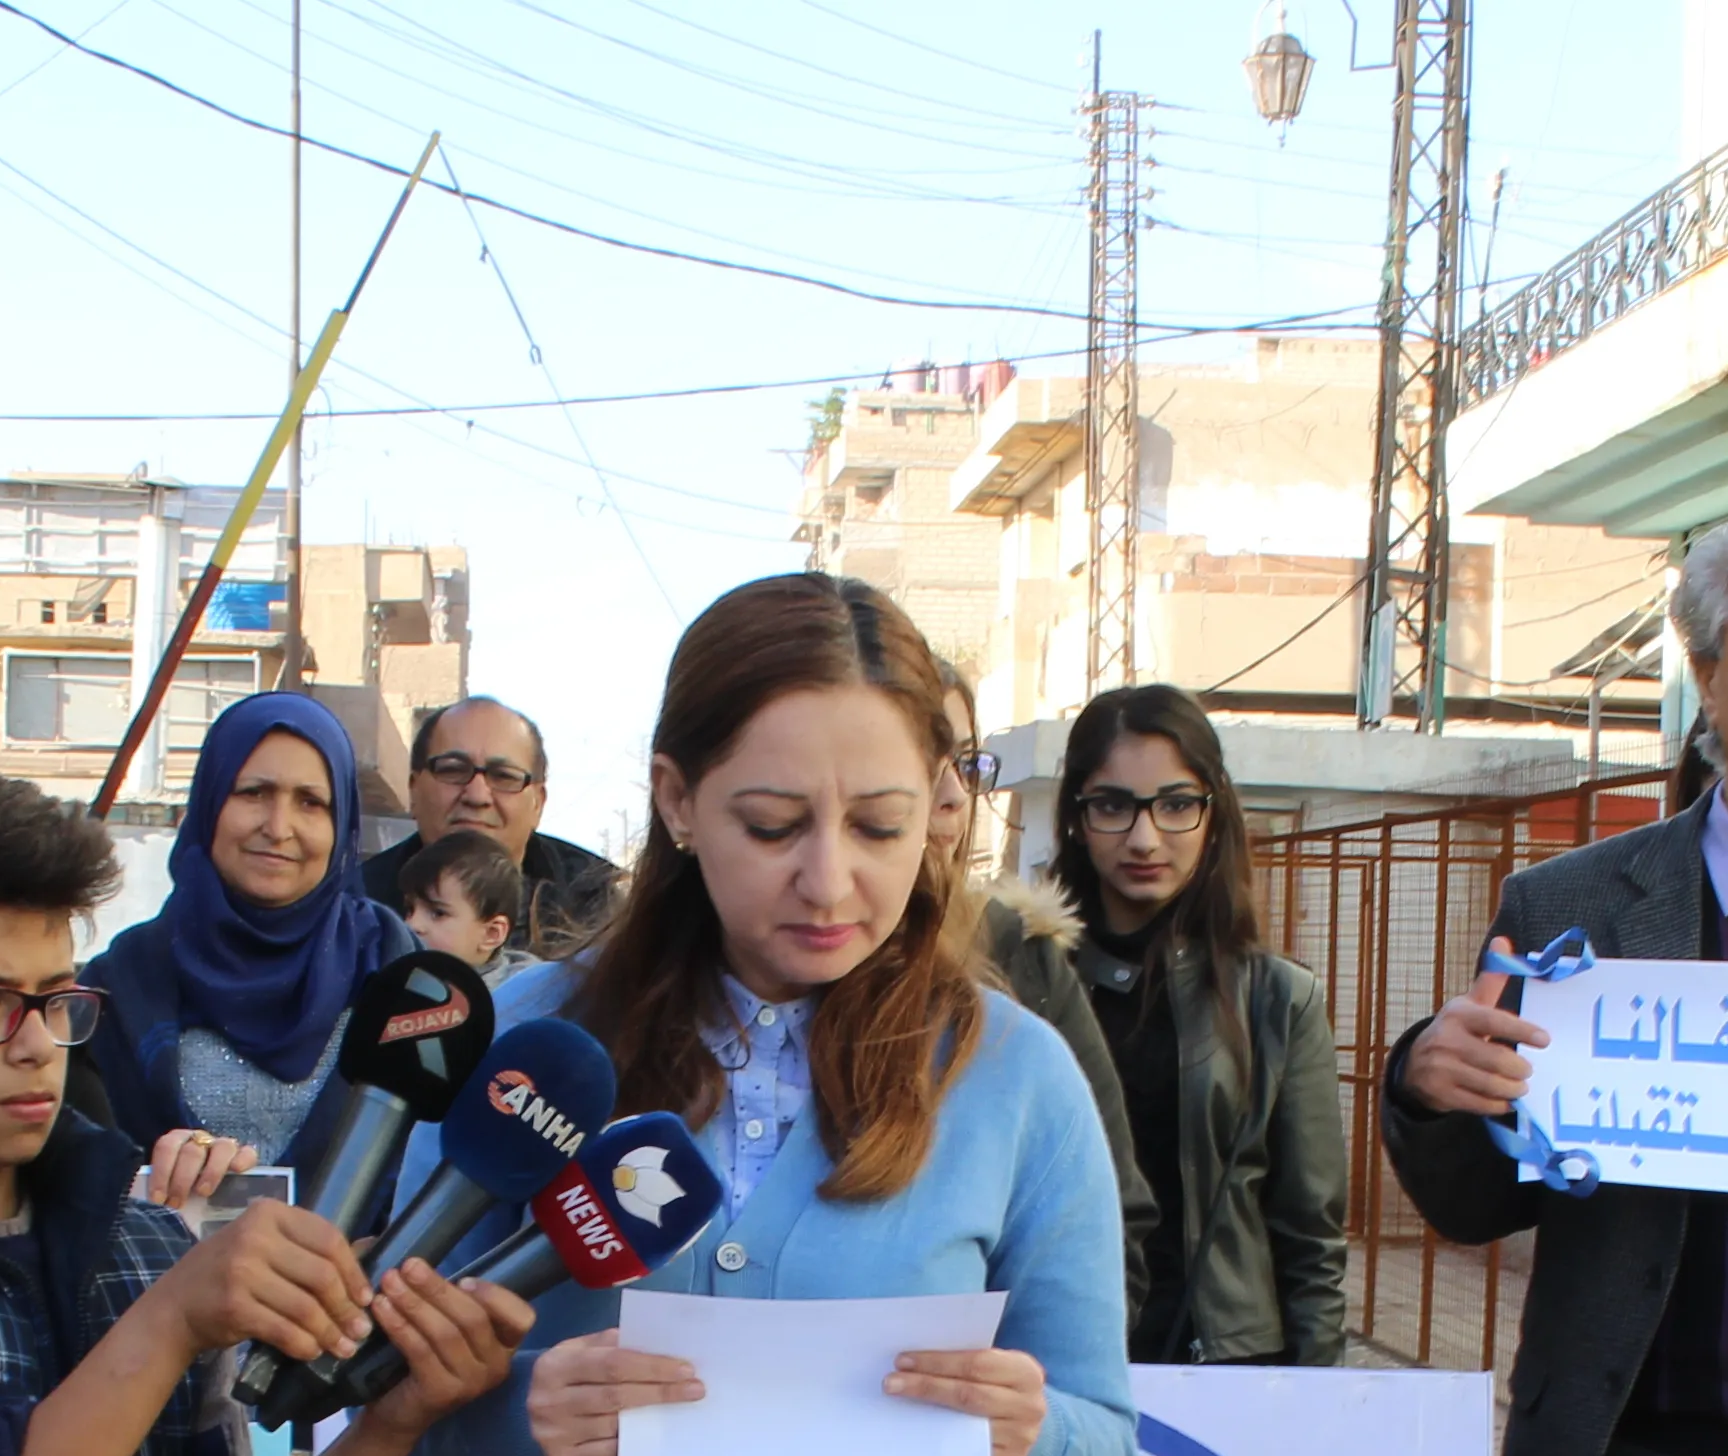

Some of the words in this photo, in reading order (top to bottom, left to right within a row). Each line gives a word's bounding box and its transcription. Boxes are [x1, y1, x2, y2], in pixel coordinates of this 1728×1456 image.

[387, 1009, 463, 1038] ROJAVA
[500, 1083, 586, 1158] ANHA
[556, 1184, 624, 1260] NEWS
